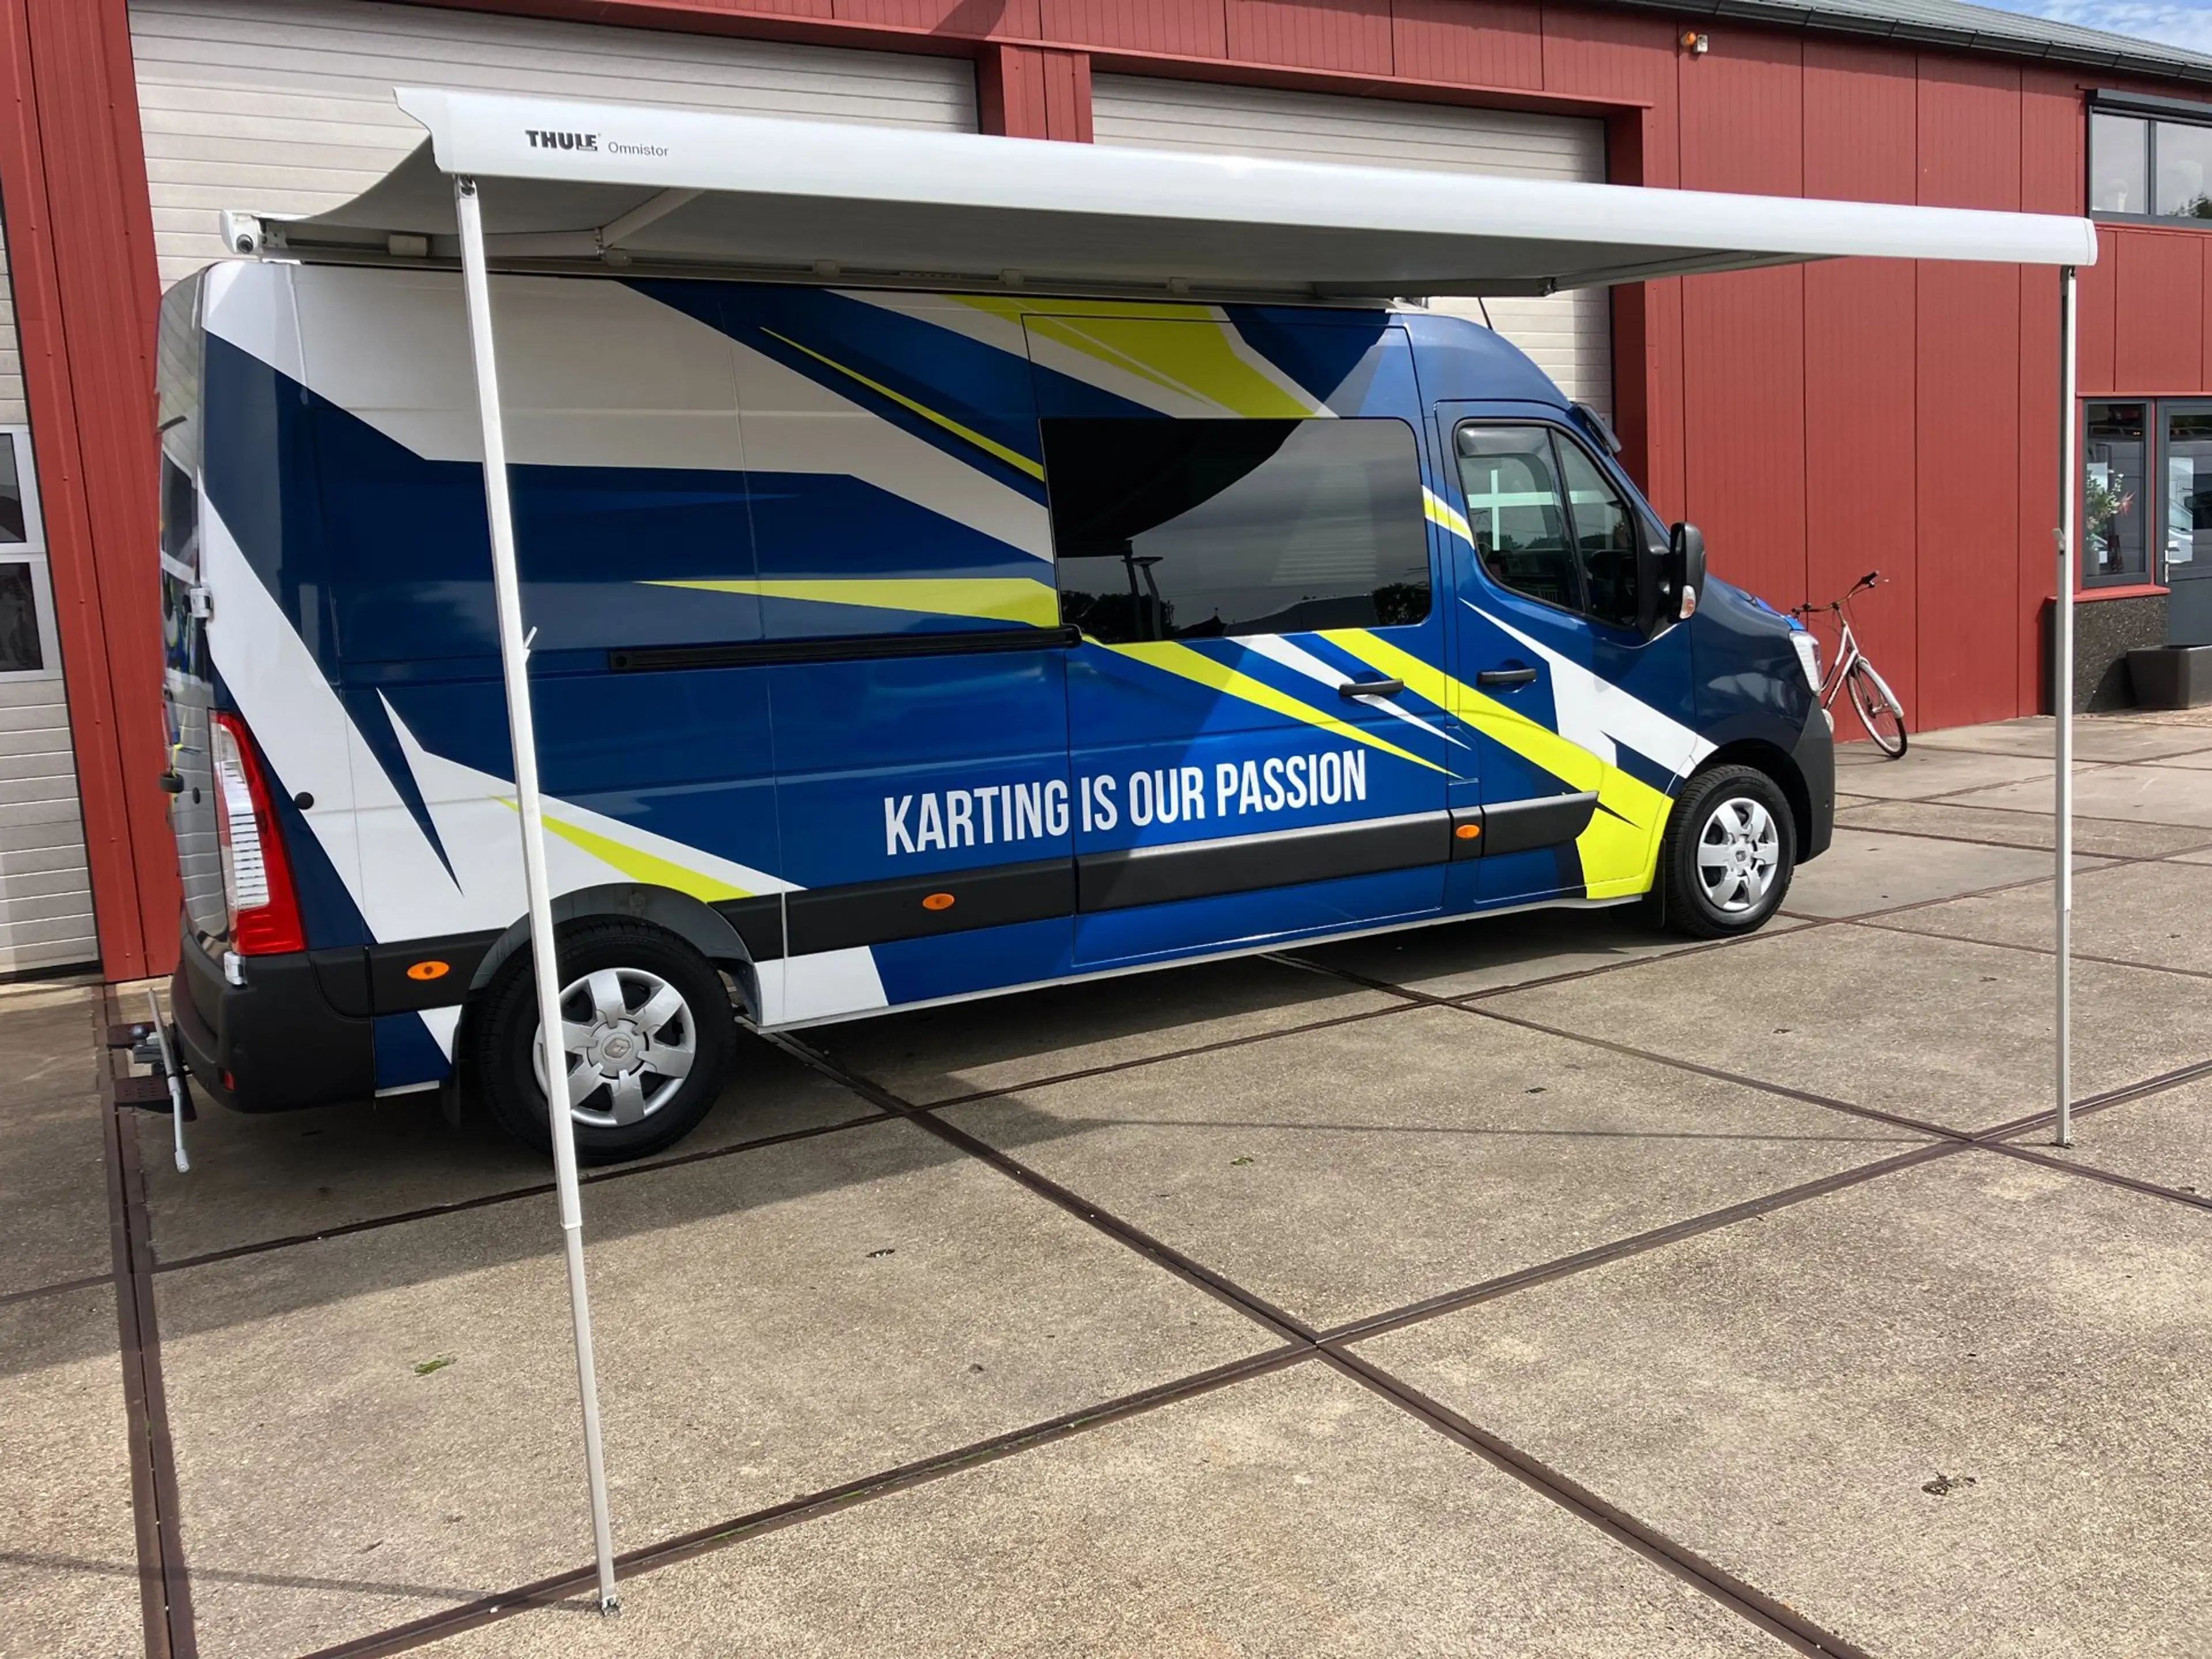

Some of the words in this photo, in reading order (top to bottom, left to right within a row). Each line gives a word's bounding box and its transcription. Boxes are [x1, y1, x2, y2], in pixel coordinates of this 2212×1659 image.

[525, 130, 599, 151] THULE
[608, 142, 669, 157] Omnistor
[884, 779, 1070, 856] KARTING
[1080, 774, 1119, 832] IS
[1129, 766, 1206, 827] OUR
[1216, 749, 1366, 817] PASSION
